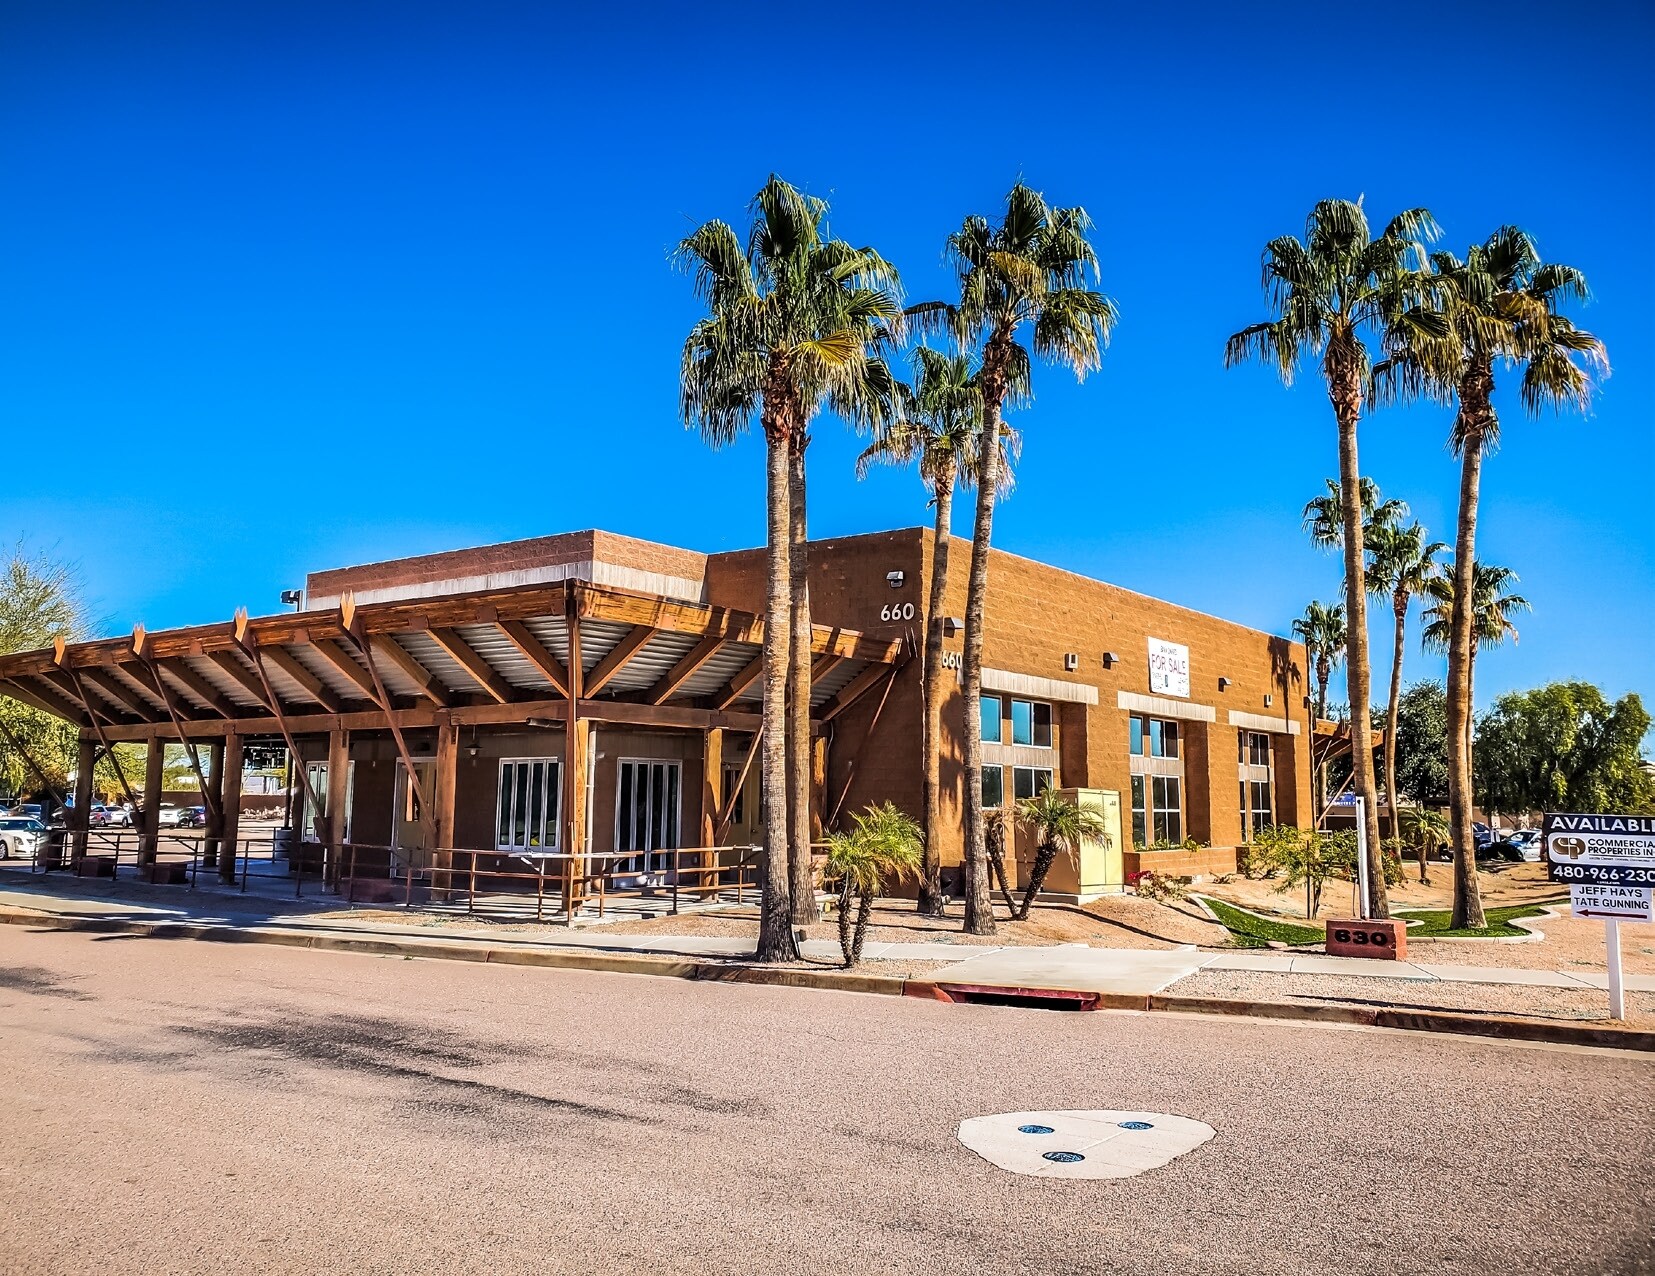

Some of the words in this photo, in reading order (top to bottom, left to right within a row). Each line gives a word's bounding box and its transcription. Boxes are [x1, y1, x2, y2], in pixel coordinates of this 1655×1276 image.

[881, 602, 915, 621] 660
[942, 650, 963, 668] 660
[1151, 653, 1167, 671] FOR
[1169, 657, 1187, 676] SALE
[1588, 838, 1655, 848] COMMERCIA
[1588, 846, 1641, 856] PROPERTIES
[1643, 848, 1655, 856] IN
[1553, 865, 1655, 882] 480-966-230
[1579, 886, 1607, 896] JEFF
[1610, 887, 1643, 898] HAYS
[1574, 897, 1600, 907] TATE
[1602, 898, 1649, 910] GUNNING
[1334, 929, 1388, 946] 630
